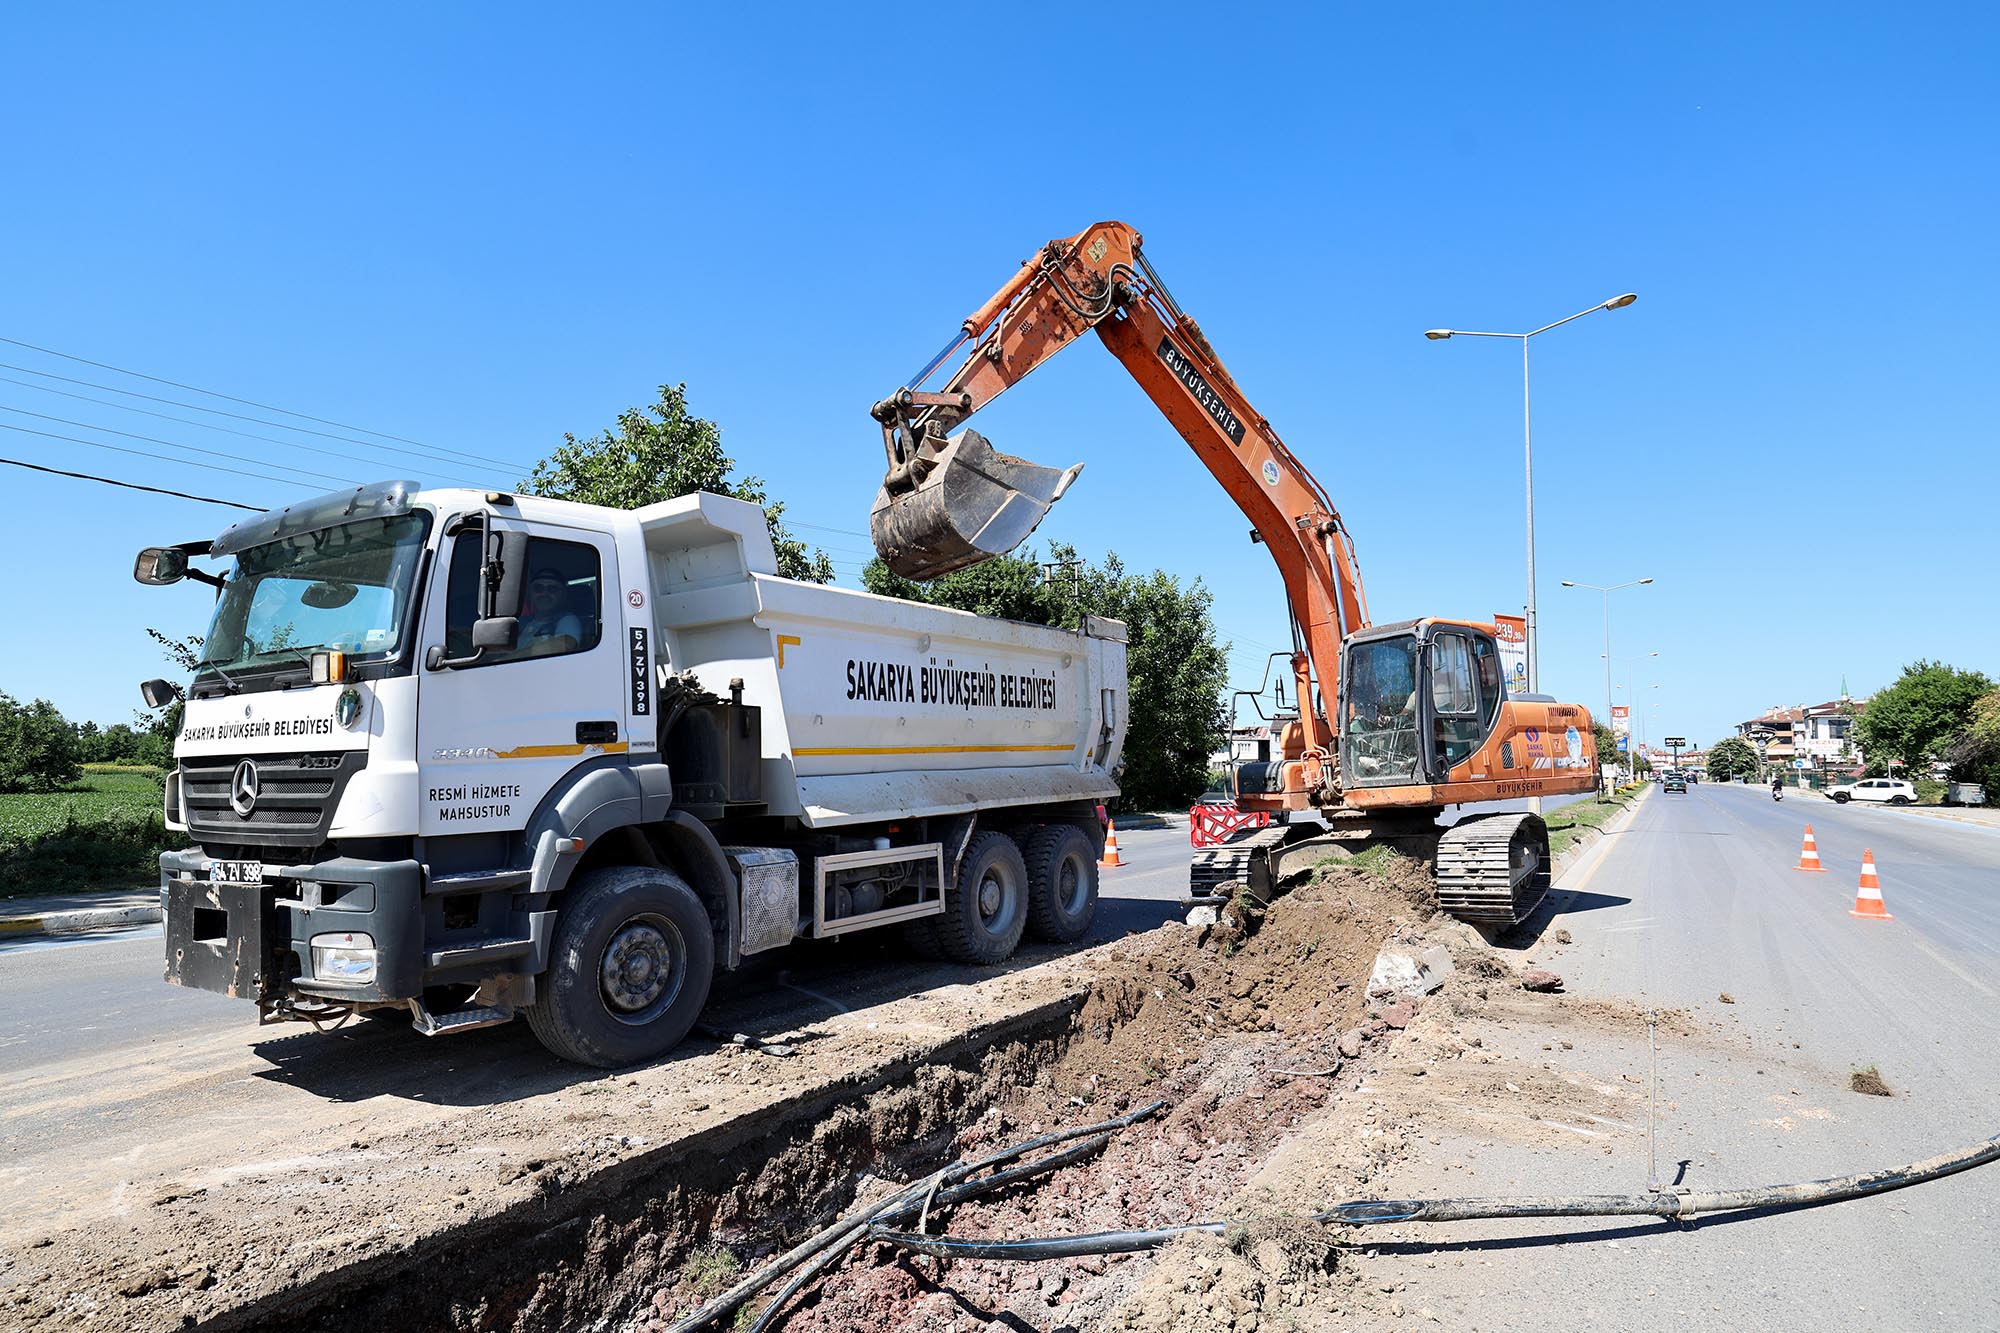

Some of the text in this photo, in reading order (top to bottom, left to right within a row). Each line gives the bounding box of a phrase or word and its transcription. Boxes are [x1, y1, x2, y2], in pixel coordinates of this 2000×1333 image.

[1166, 349, 1237, 435] BÜYÜKŞEHİR
[630, 593, 642, 605] 20
[846, 657, 1057, 711] SAKARYA BÜYÜKŞEHİR BELEDİYESİ
[636, 681, 646, 713] 398
[184, 714, 334, 742] SAKARYA BÜYÜKŞEHİR BELEDİYESİ
[429, 783, 521, 801] RESMİ HİZMETE
[439, 804, 511, 821] MAHSUSTUR
[215, 861, 261, 882] 54 ZV 398
